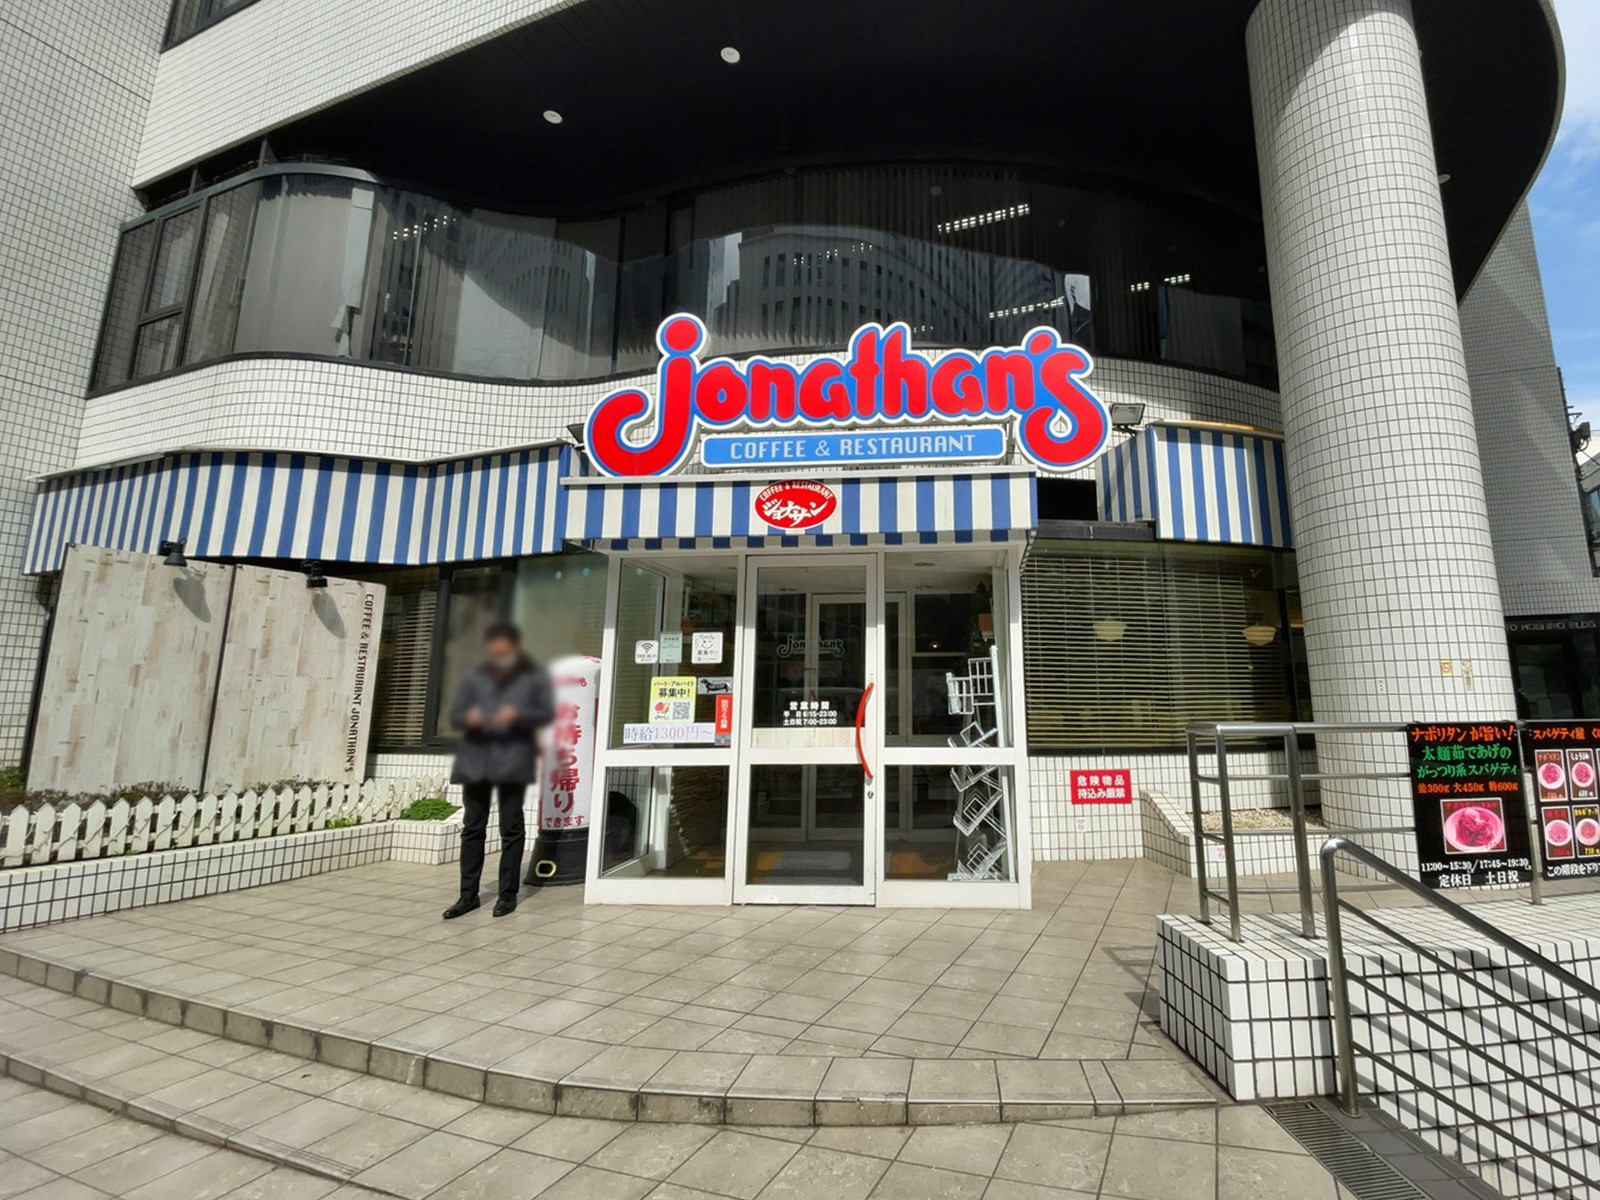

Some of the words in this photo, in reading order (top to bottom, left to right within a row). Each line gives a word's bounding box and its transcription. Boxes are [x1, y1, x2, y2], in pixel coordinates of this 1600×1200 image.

[591, 317, 1106, 476] jonathan's
[730, 439, 806, 460] COFFEE
[814, 439, 832, 457] &
[839, 434, 975, 456] RESTAURANT
[759, 484, 784, 503] COFFEE
[784, 482, 791, 490] &
[792, 481, 834, 500] RESTAURANT
[362, 593, 374, 630] COFFEE
[360, 632, 370, 640] &
[352, 642, 368, 706] RESTAURANT
[344, 707, 360, 773] JONATHAN'S
[1411, 725, 1467, 742] ナポリタン
[1077, 775, 1124, 786] 危険物品
[1078, 788, 1126, 800] 持込み厳禁
[545, 815, 585, 828] できます
[1438, 874, 1472, 888] 定休日
[1485, 870, 1520, 885] 土日祝
